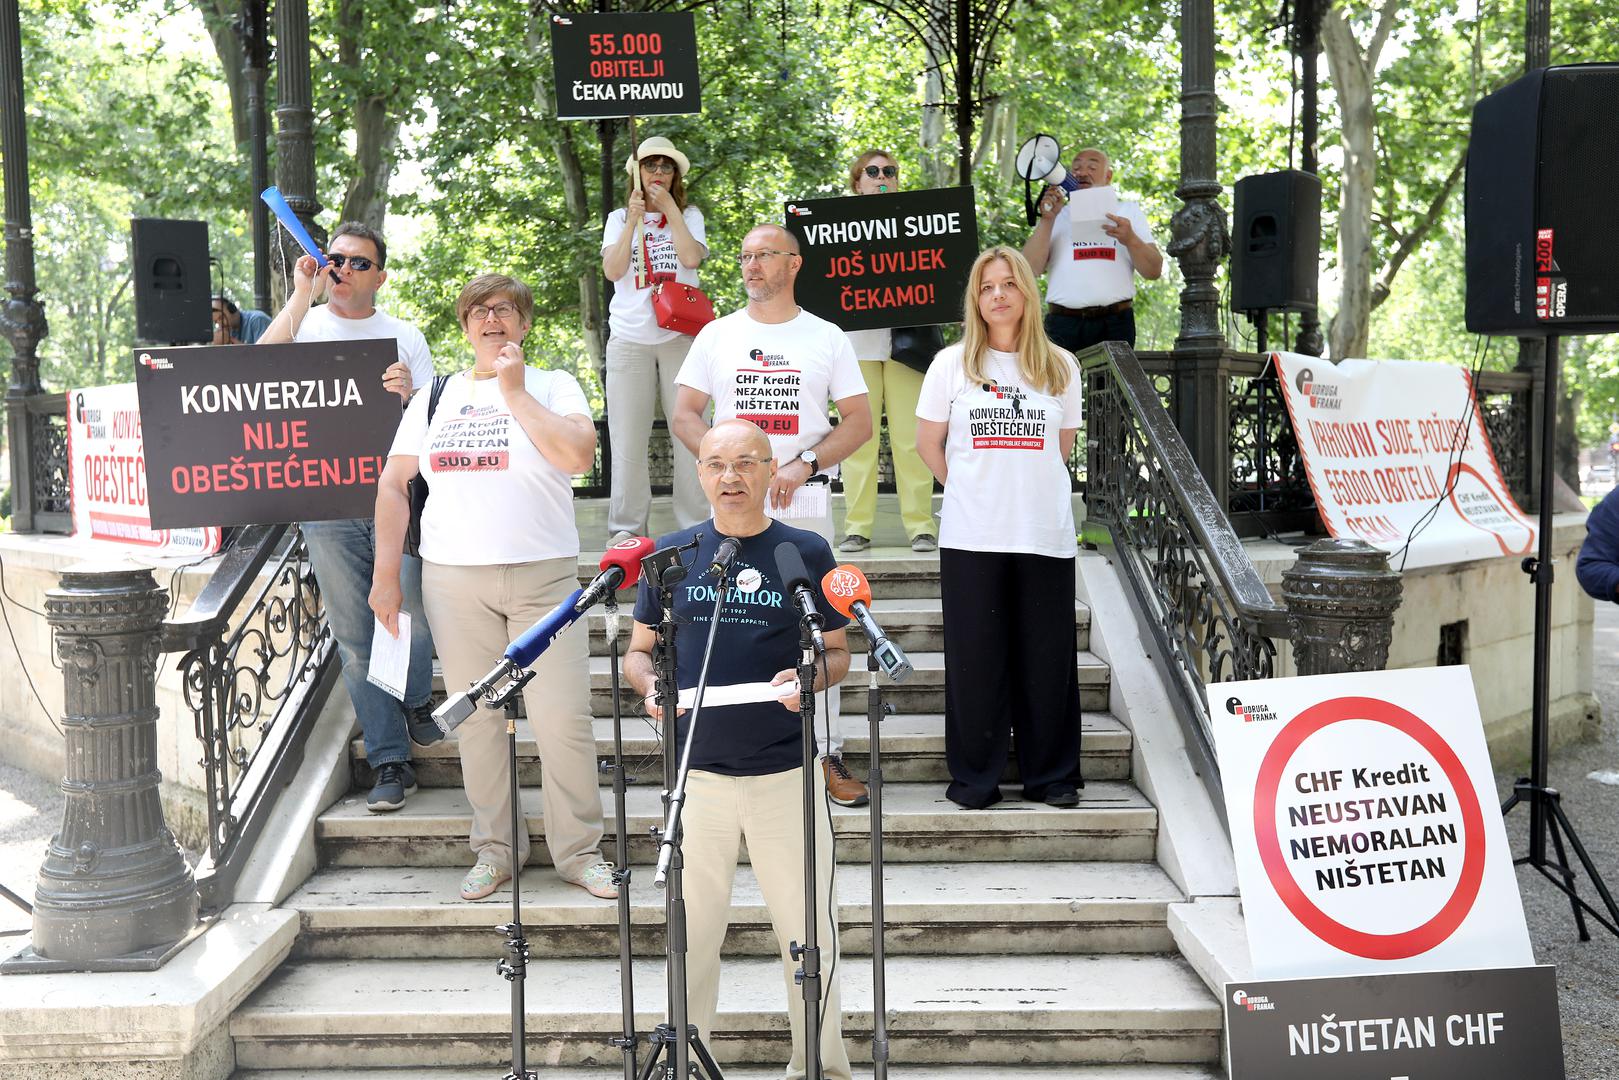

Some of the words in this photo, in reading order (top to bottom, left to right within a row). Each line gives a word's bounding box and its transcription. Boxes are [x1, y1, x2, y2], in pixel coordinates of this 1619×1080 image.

[589, 34, 662, 55] 55.000
[590, 60, 664, 78] OBITELJI
[573, 81, 616, 101] ČEKA
[620, 83, 683, 100] PRAVDU
[804, 218, 898, 245] VRHOVNI
[904, 213, 961, 237] SUDE
[825, 250, 864, 278] JOŠ
[871, 248, 946, 274] UVIJEK
[840, 284, 935, 311] ČEKAMO!
[1556, 283, 1568, 317] OPERA
[736, 375, 759, 384] CHF
[763, 376, 800, 385] Kredit
[1312, 384, 1338, 396] UDRUGA
[180, 378, 363, 414] KONVERZIJA
[736, 388, 799, 397] NEZAKONIT
[736, 397, 799, 411] NIŠTETAN
[970, 408, 1024, 420] KONVERZIJA
[1027, 409, 1046, 420] NIJE
[243, 420, 308, 450] NIJE
[773, 420, 791, 430] EU
[970, 419, 1045, 437] OBEŠTEĆENJE!
[431, 438, 508, 449] NIŠTETAN
[1307, 419, 1378, 458] VRHOVNI
[1376, 419, 1422, 459] SUDE,
[438, 457, 471, 467] SUD
[478, 456, 499, 466] EU
[171, 454, 382, 494] OBEŠTEĆENJE!
[1324, 468, 1380, 506] 55000
[1374, 465, 1442, 503] OBITELJI
[686, 586, 717, 602] TOM
[726, 587, 782, 608] TAILOR
[741, 618, 769, 626] APPAREL
[1244, 704, 1269, 713] UDRUGA
[1252, 712, 1277, 721] FRANAK
[1295, 770, 1342, 794] CHF
[1352, 763, 1430, 789] Kredit
[1288, 792, 1447, 827] NEUSTAVAN
[1290, 823, 1457, 860] NEMORALAN
[1316, 856, 1446, 891] NIŠTETAN
[1288, 1013, 1436, 1056] NIŠTETAN
[1446, 1012, 1504, 1047] CHF
